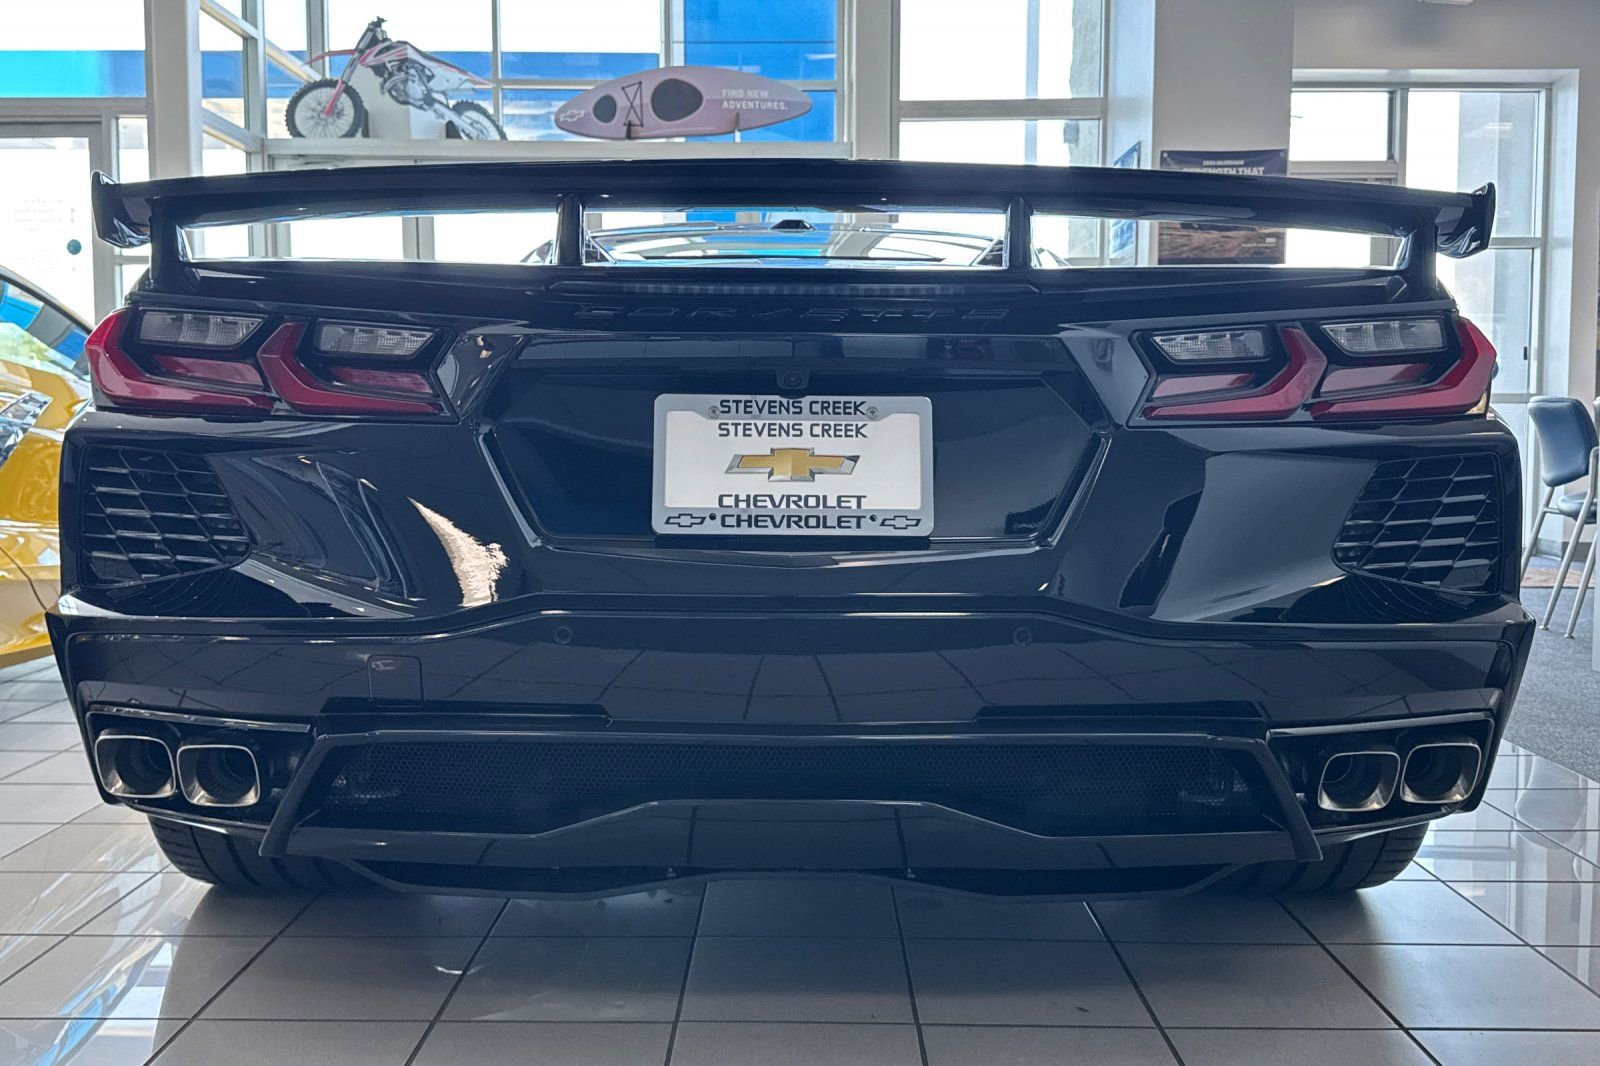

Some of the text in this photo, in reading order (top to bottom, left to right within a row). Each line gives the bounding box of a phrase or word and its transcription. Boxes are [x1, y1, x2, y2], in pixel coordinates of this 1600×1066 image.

[722, 89, 769, 98] FIND NEW
[722, 101, 789, 110] ADVENTURES.
[1238, 167, 1264, 175] THAT
[719, 400, 867, 415] STEVENS CREEK
[718, 423, 868, 438] STEVENS CREEK
[718, 494, 867, 509] CHEVROLET
[720, 514, 866, 529] CHEVROLET
